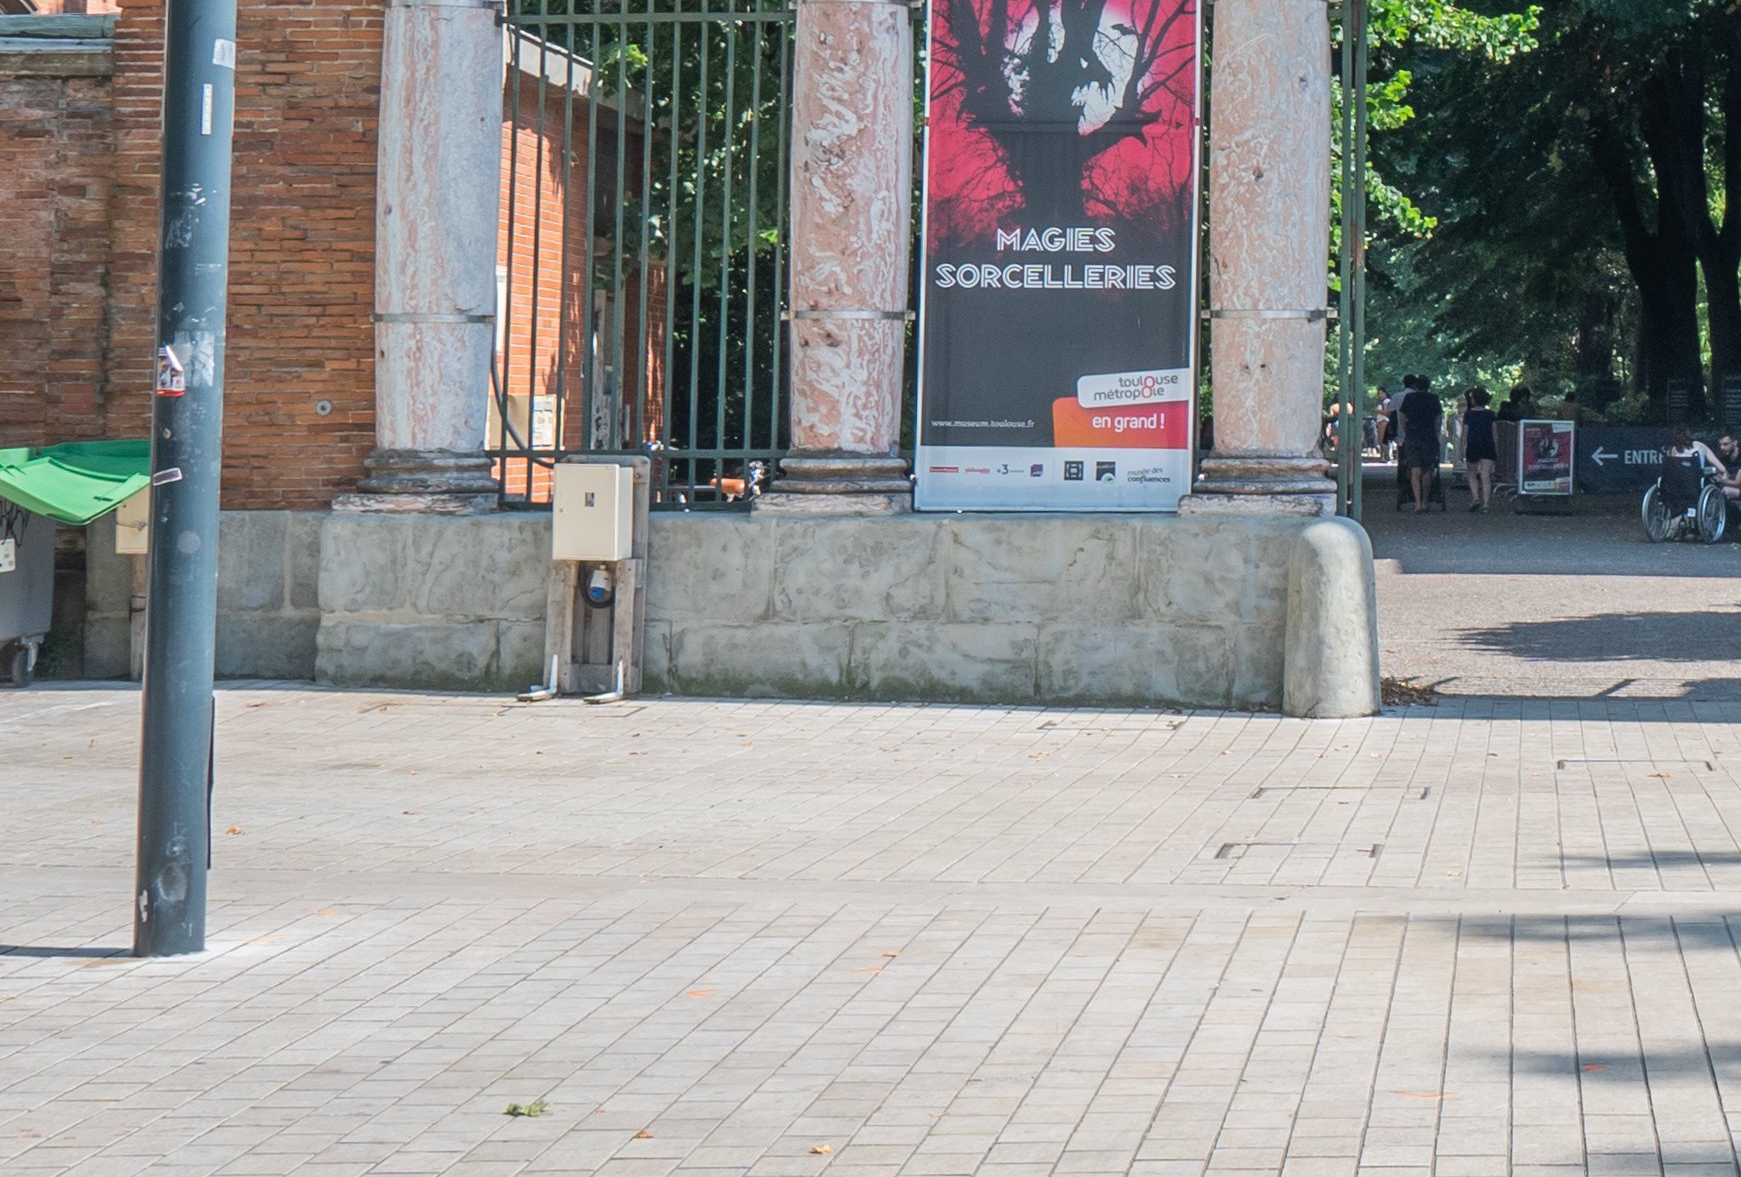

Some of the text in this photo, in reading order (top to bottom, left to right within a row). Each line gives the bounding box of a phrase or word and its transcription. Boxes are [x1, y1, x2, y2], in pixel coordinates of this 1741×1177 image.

[997, 227, 1116, 253] MAGIES
[935, 263, 1176, 290] SORCELLERIES
[1119, 375, 1179, 388] toulouse
[931, 419, 1035, 428] www.museum.toulouse.fr
[1092, 413, 1165, 433] en grand !
